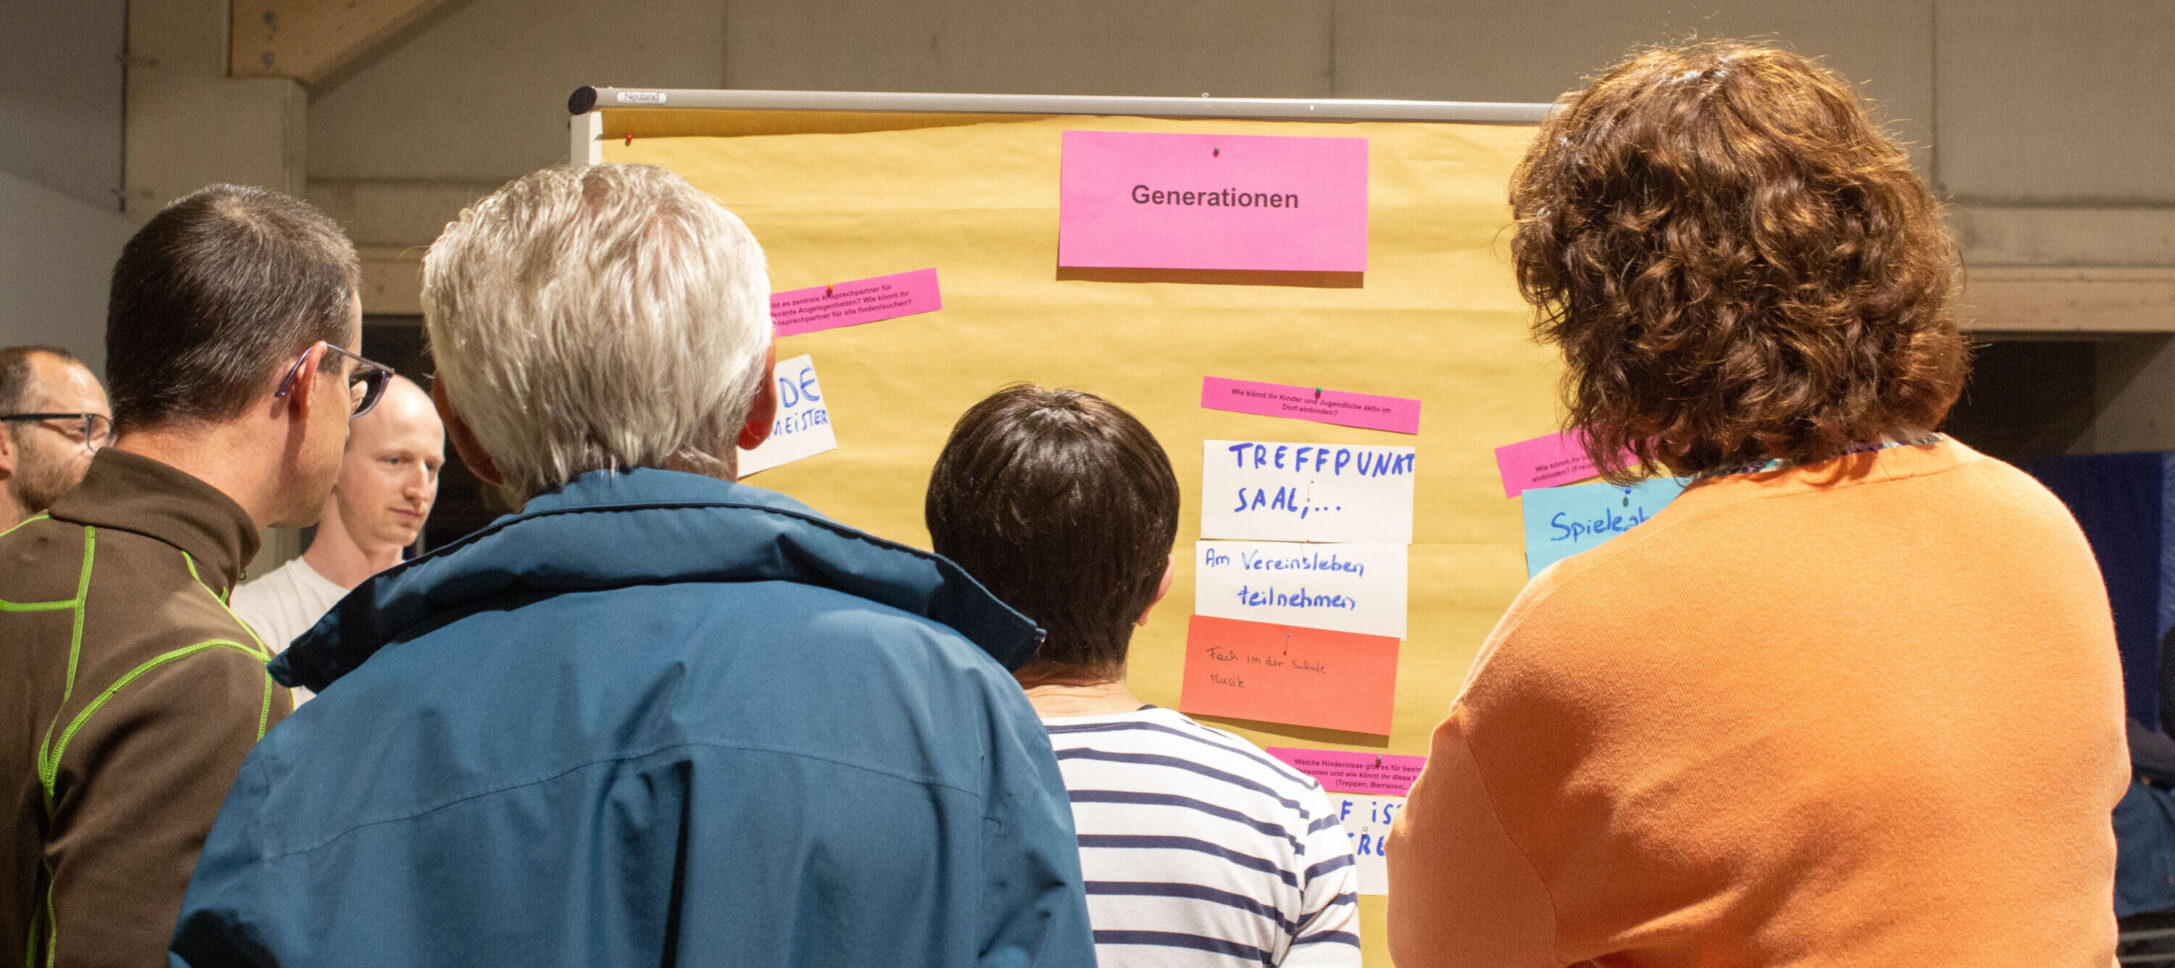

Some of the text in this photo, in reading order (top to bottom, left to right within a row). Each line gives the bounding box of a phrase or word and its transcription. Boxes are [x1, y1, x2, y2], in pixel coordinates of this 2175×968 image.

[1131, 184, 1299, 209] Generationen
[792, 296, 820, 306] zentrale
[881, 284, 892, 292] für
[798, 299, 862, 314] Angelegenheiten?
[877, 293, 898, 302] könnt
[832, 310, 843, 318] für
[844, 308, 857, 316] alle
[858, 299, 912, 313] finden/suchen?
[1231, 388, 1245, 396] Wie
[1246, 391, 1267, 399] könnt
[1279, 395, 1303, 403] Kinder
[1319, 400, 1363, 411] Jugendliche
[1282, 403, 1338, 416] Dorf einbinden?
[1228, 442, 1415, 478] TREFFPUNKT
[1535, 465, 1548, 473] Wie
[1549, 458, 1570, 469] könnt
[1532, 468, 1570, 482] einbinden?
[1205, 548, 1364, 577] Am Vereinsleben
[1237, 585, 1355, 610] teilnehmen
[1322, 760, 1363, 769] Hindernisse
[1335, 780, 1368, 788] (Treppen,
[1359, 772, 1379, 780] könnt
